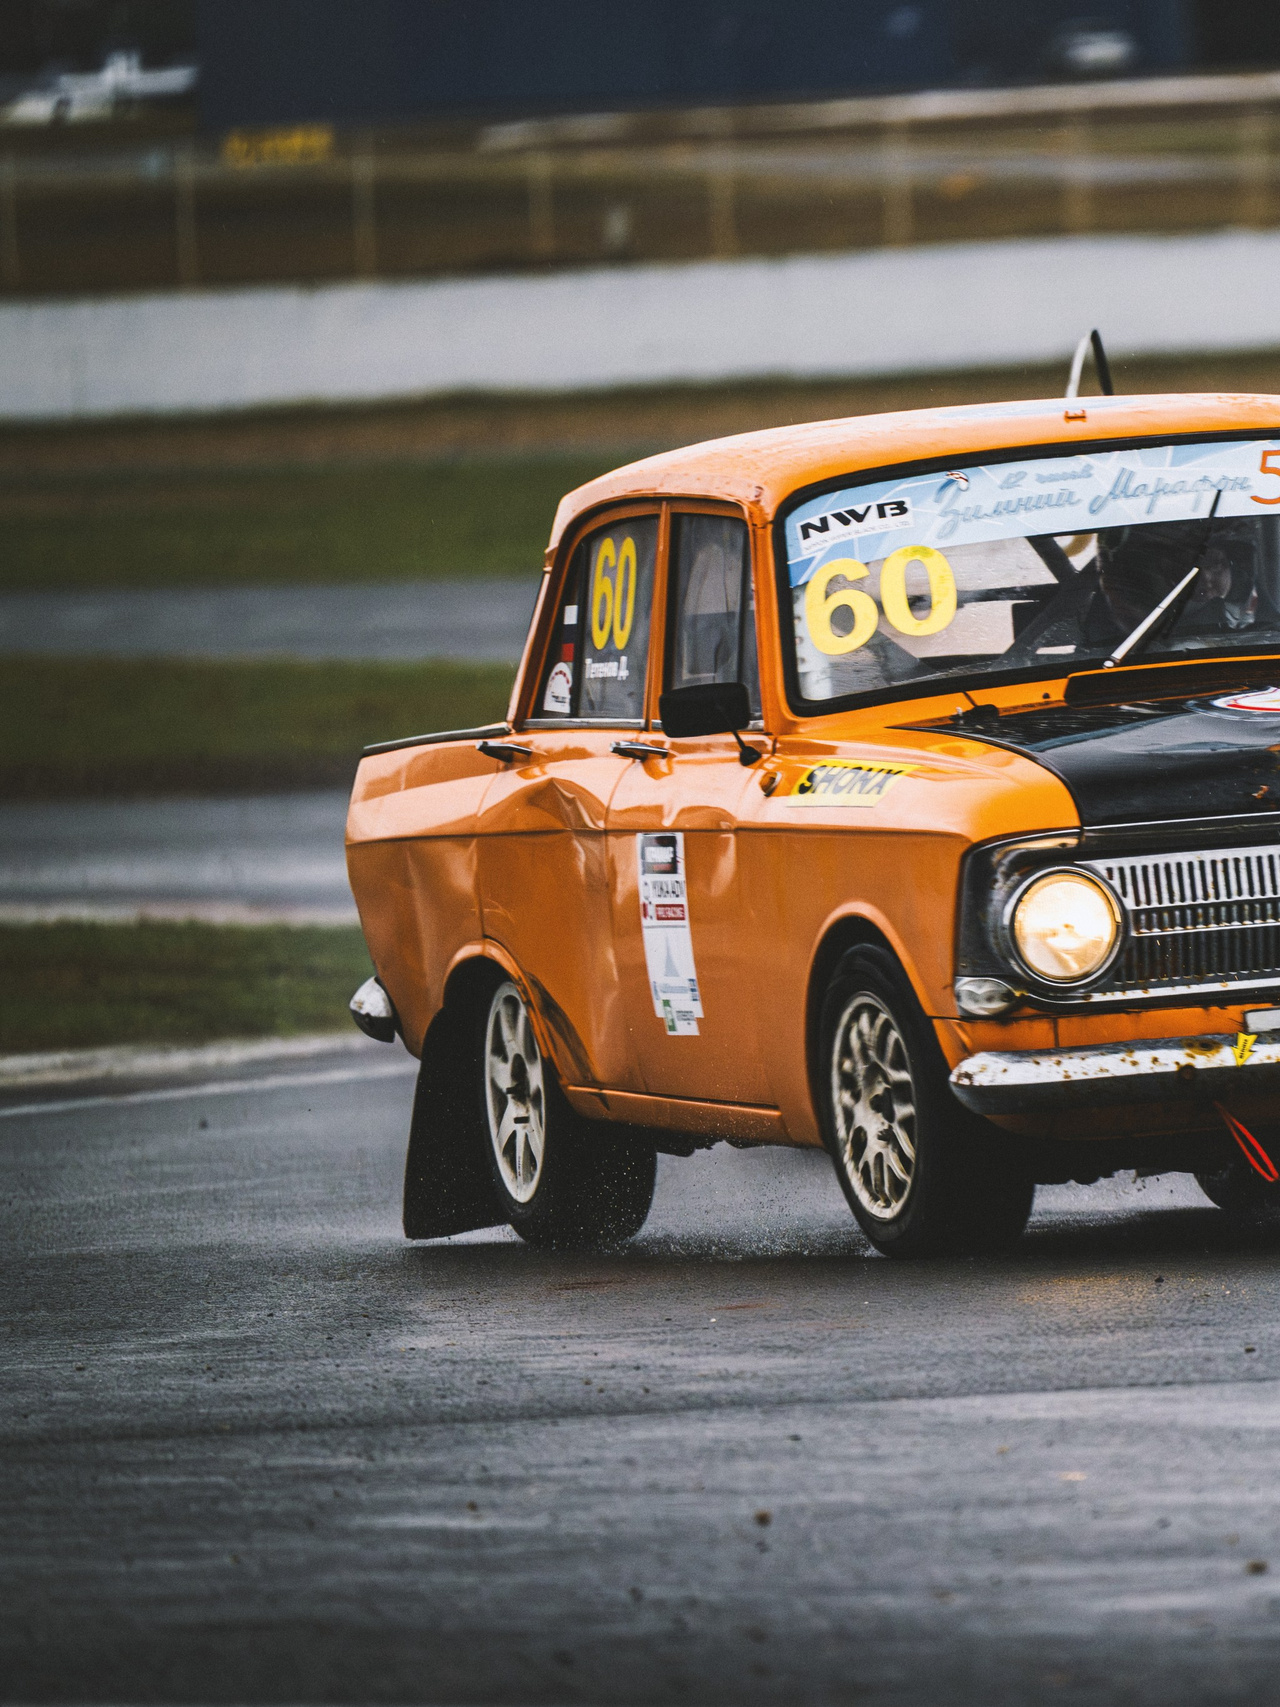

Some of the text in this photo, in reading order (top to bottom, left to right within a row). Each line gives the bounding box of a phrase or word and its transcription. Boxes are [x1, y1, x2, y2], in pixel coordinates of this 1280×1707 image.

[799, 499, 910, 541] NWB
[591, 536, 637, 650] 60
[804, 545, 957, 656] 60
